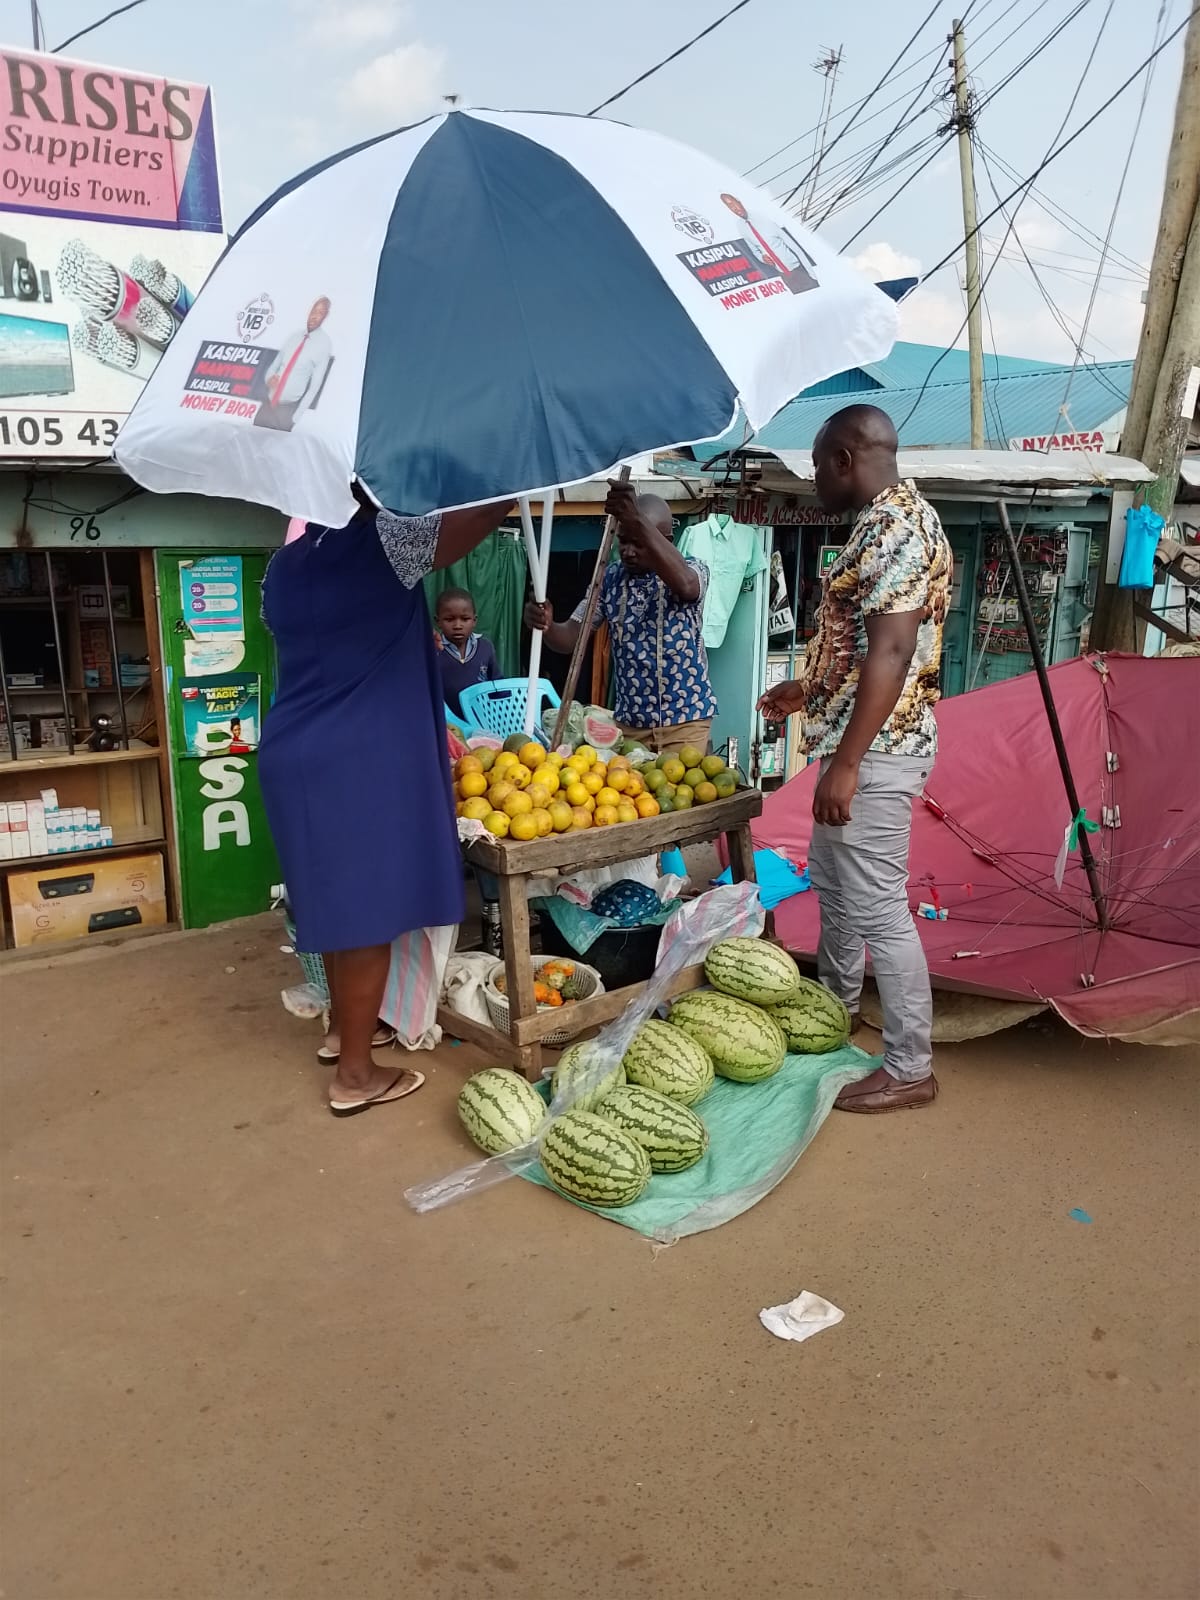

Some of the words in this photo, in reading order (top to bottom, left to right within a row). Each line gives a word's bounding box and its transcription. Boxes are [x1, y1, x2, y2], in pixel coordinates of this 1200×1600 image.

[3, 56, 193, 140] RISES
[3, 124, 163, 170] Suppliers
[3, 168, 80, 200] Oyugis
[88, 179, 150, 206] Town.
[685, 244, 741, 268] KASIPUL
[709, 275, 749, 294] KASIPUL
[720, 286, 760, 310] MONEY
[759, 280, 787, 298] BIOR
[243, 314, 263, 330] MB
[203, 344, 262, 365] KASIPUL
[190, 378, 231, 393] KASIPUL
[180, 394, 225, 413] MONEY
[224, 399, 257, 419] BIOR
[77, 418, 119, 447] 43
[1022, 431, 1104, 451] NYANZA
[70, 515, 101, 541] 96
[206, 690, 239, 700] MAGIC
